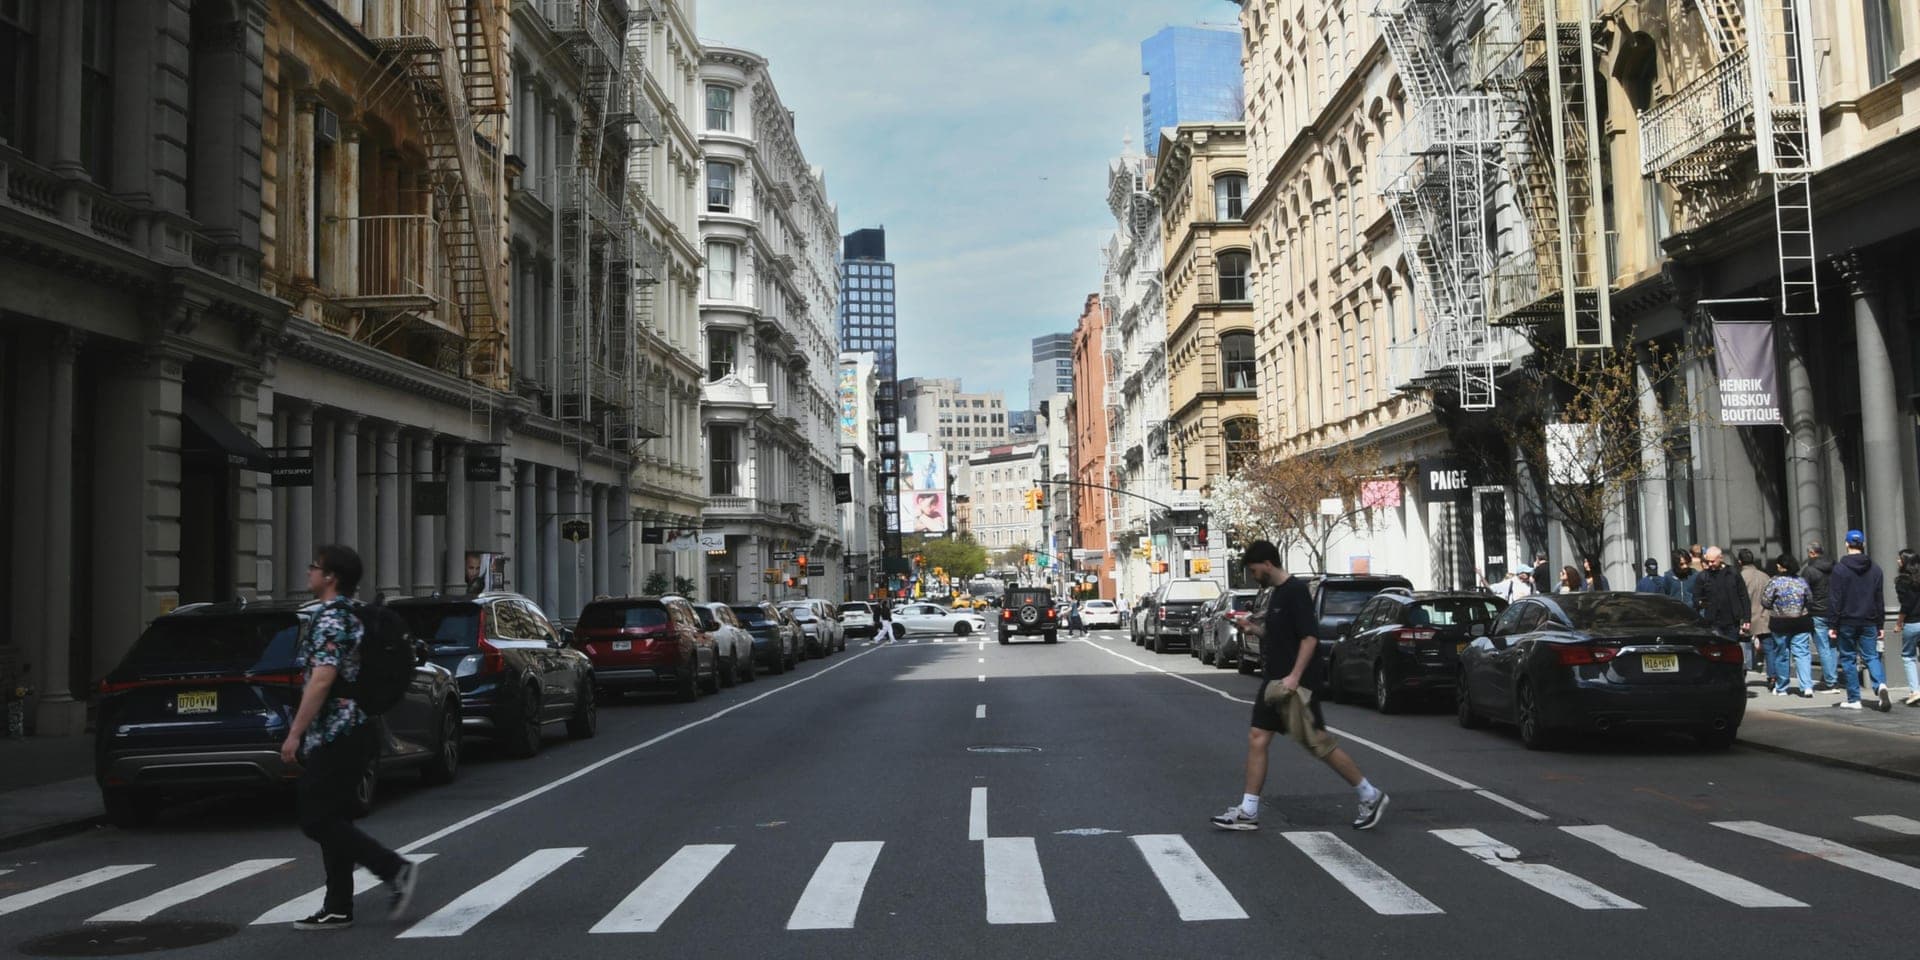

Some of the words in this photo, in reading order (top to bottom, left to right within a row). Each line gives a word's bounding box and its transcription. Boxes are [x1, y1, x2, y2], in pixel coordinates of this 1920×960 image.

[1719, 378, 1763, 391] HENRIK
[1720, 393, 1771, 406] VIBSKOV
[1721, 407, 1781, 421] BOUTIQUE
[1430, 470, 1468, 490] PAIGE
